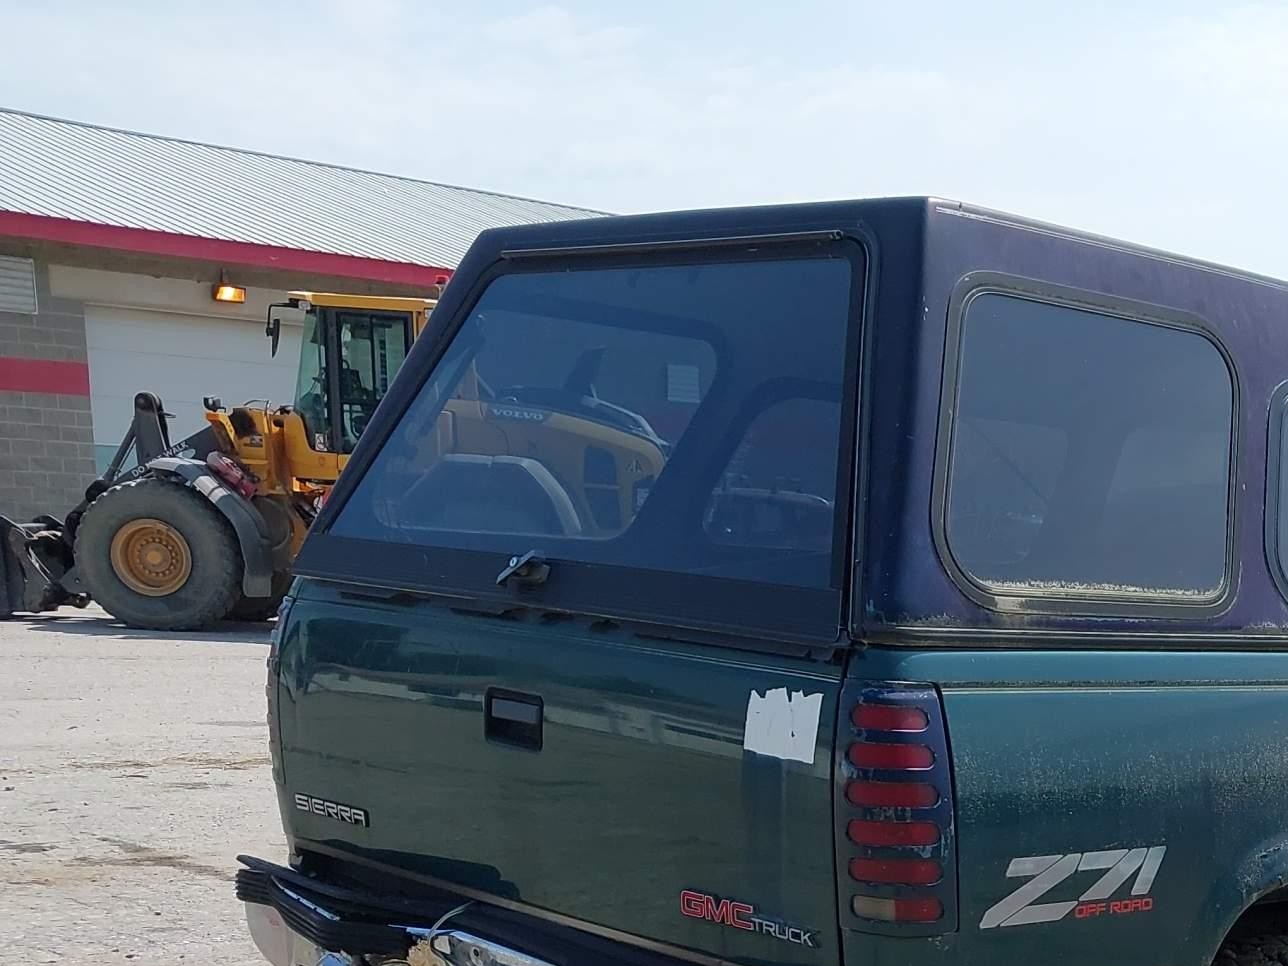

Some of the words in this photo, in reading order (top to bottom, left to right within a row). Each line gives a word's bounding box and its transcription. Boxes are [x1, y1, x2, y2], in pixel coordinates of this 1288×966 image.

[492, 408, 544, 421] VOLVO
[163, 441, 189, 457] WALK
[294, 793, 366, 827] SIERRA
[979, 846, 1167, 929] Z71
[681, 890, 754, 931] GMC
[751, 917, 813, 947] TRUCK
[1074, 902, 1106, 918] OFF
[1109, 898, 1153, 914] ROAD
